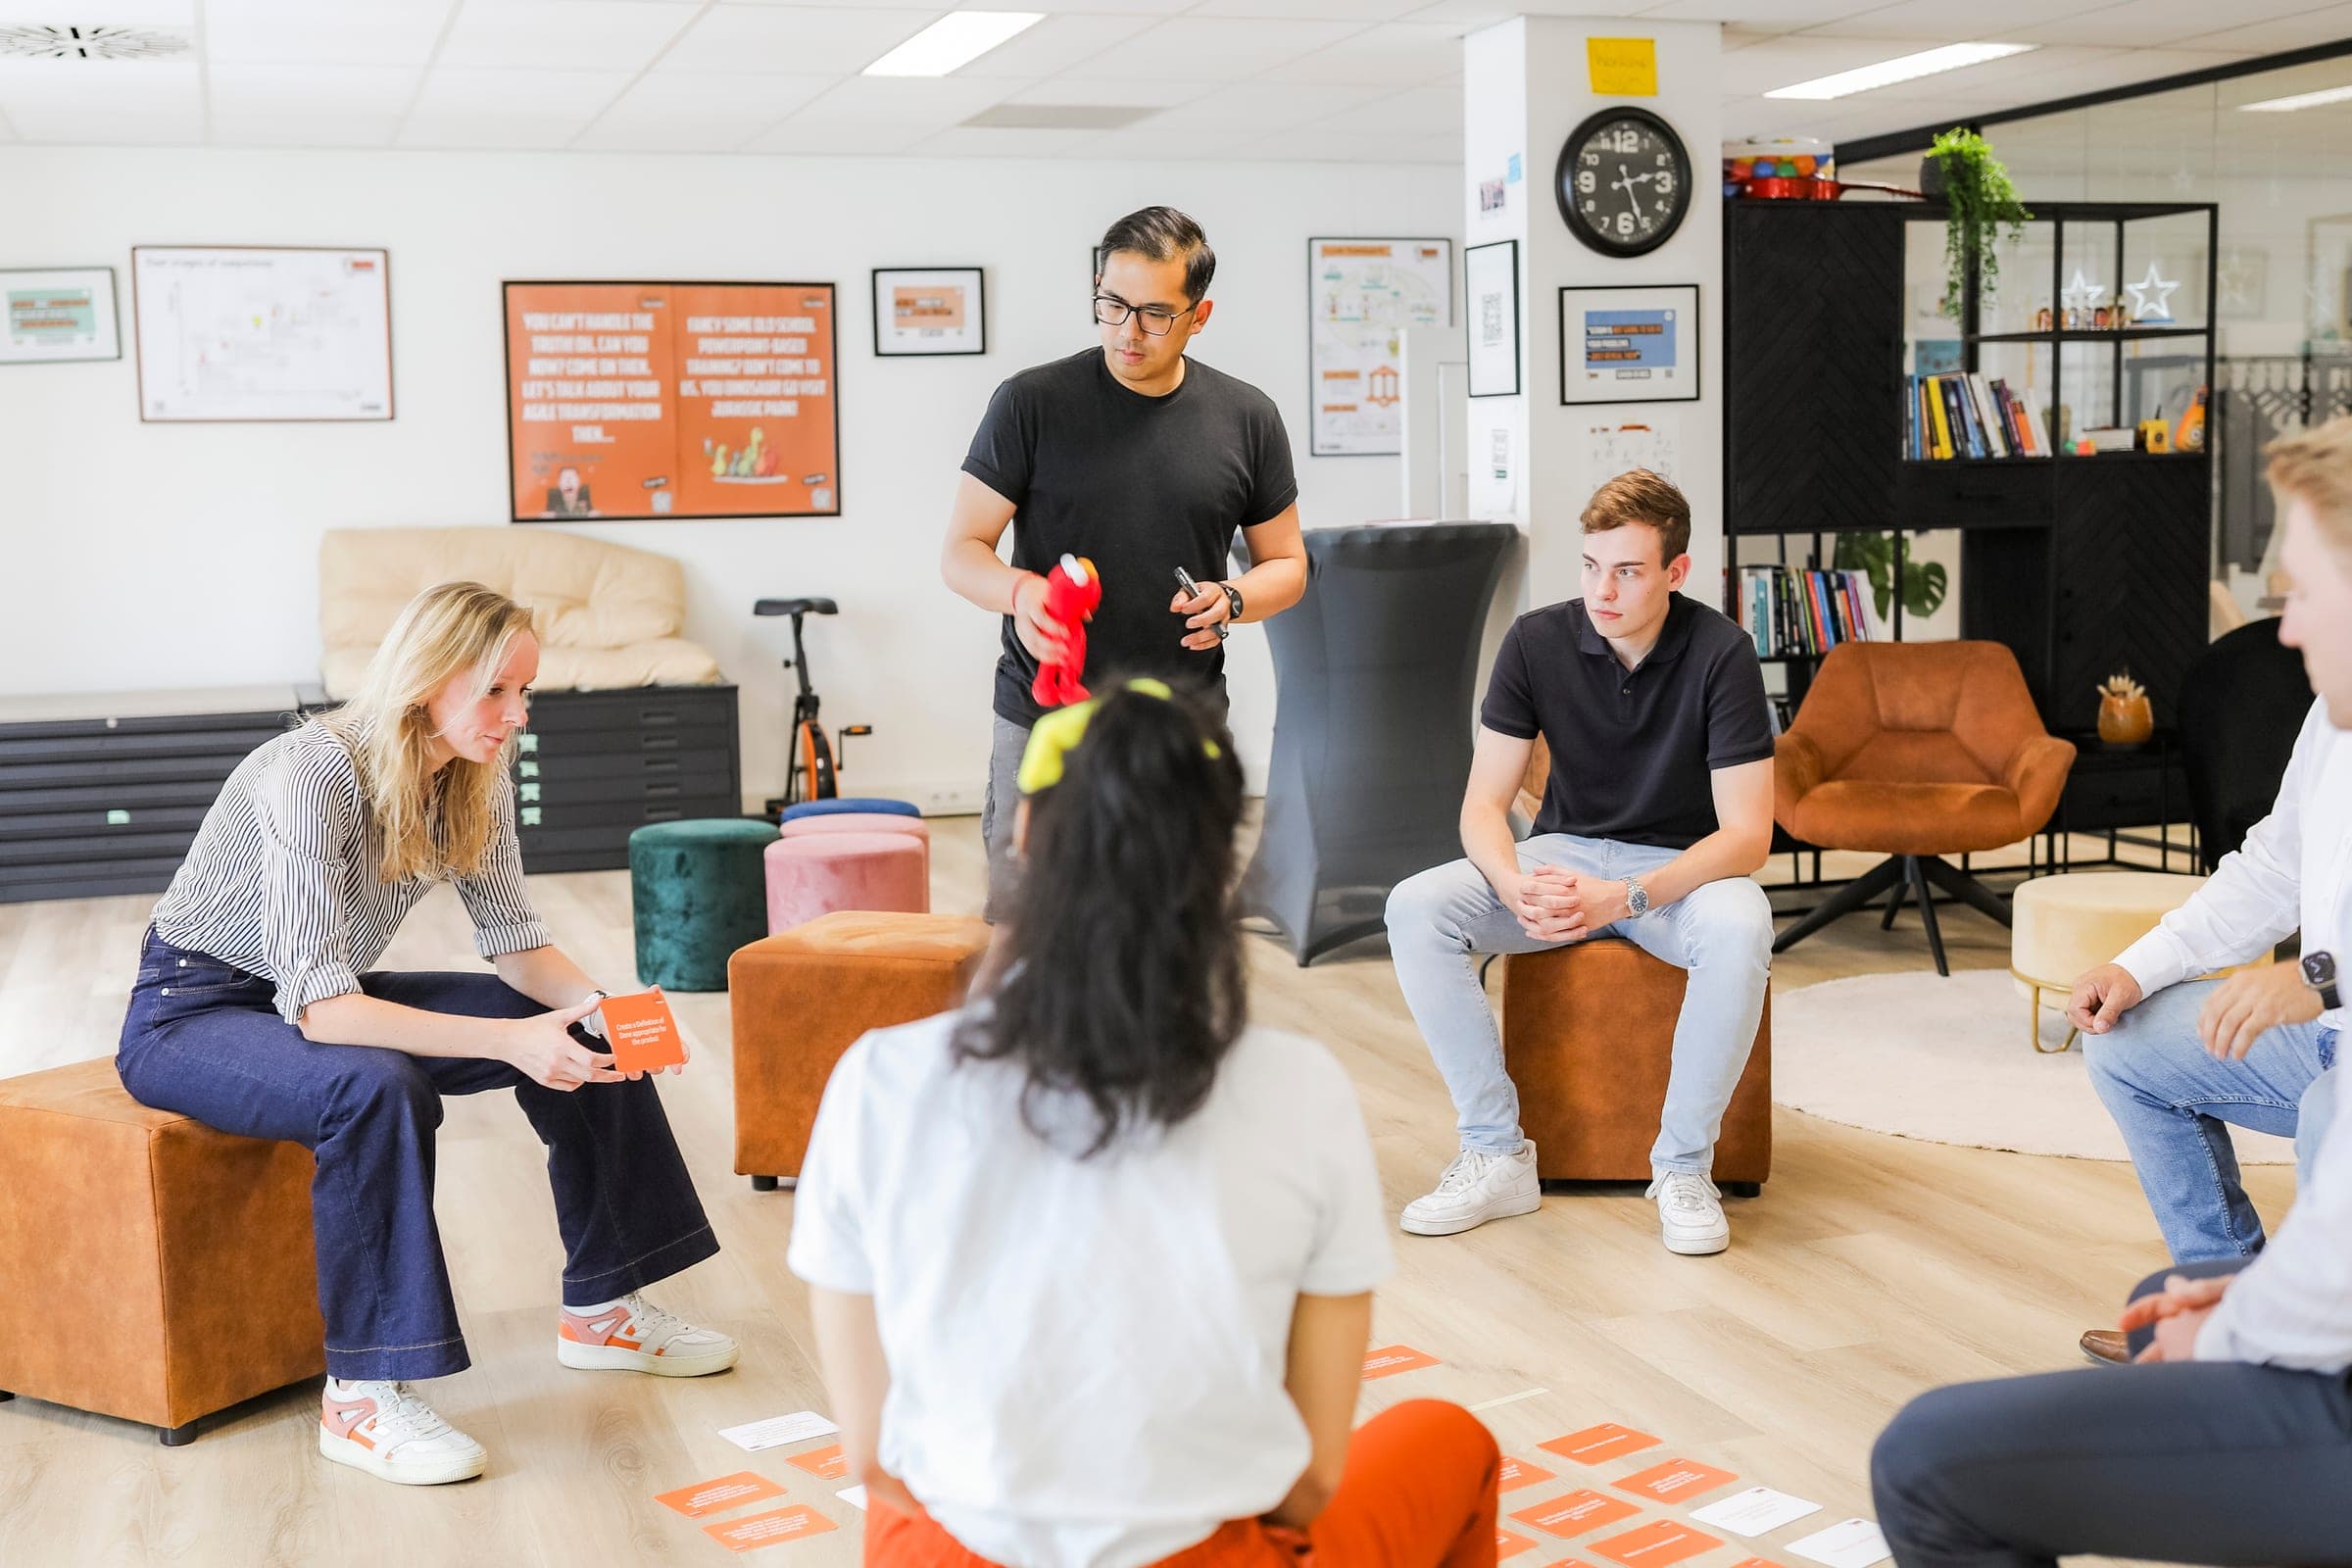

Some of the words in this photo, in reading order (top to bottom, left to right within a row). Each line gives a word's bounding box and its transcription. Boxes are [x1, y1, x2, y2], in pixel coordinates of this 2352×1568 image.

[1613, 130, 1639, 153] 12
[1586, 154, 1599, 166] 10
[1656, 154, 1666, 167] 2
[1579, 171, 1595, 193] 9
[1654, 171, 1672, 194] 3
[1586, 200, 1595, 212] 8
[1655, 200, 1664, 212] 4
[1600, 217, 1610, 228] 7
[1617, 212, 1635, 235] 6
[1642, 217, 1651, 229] 5
